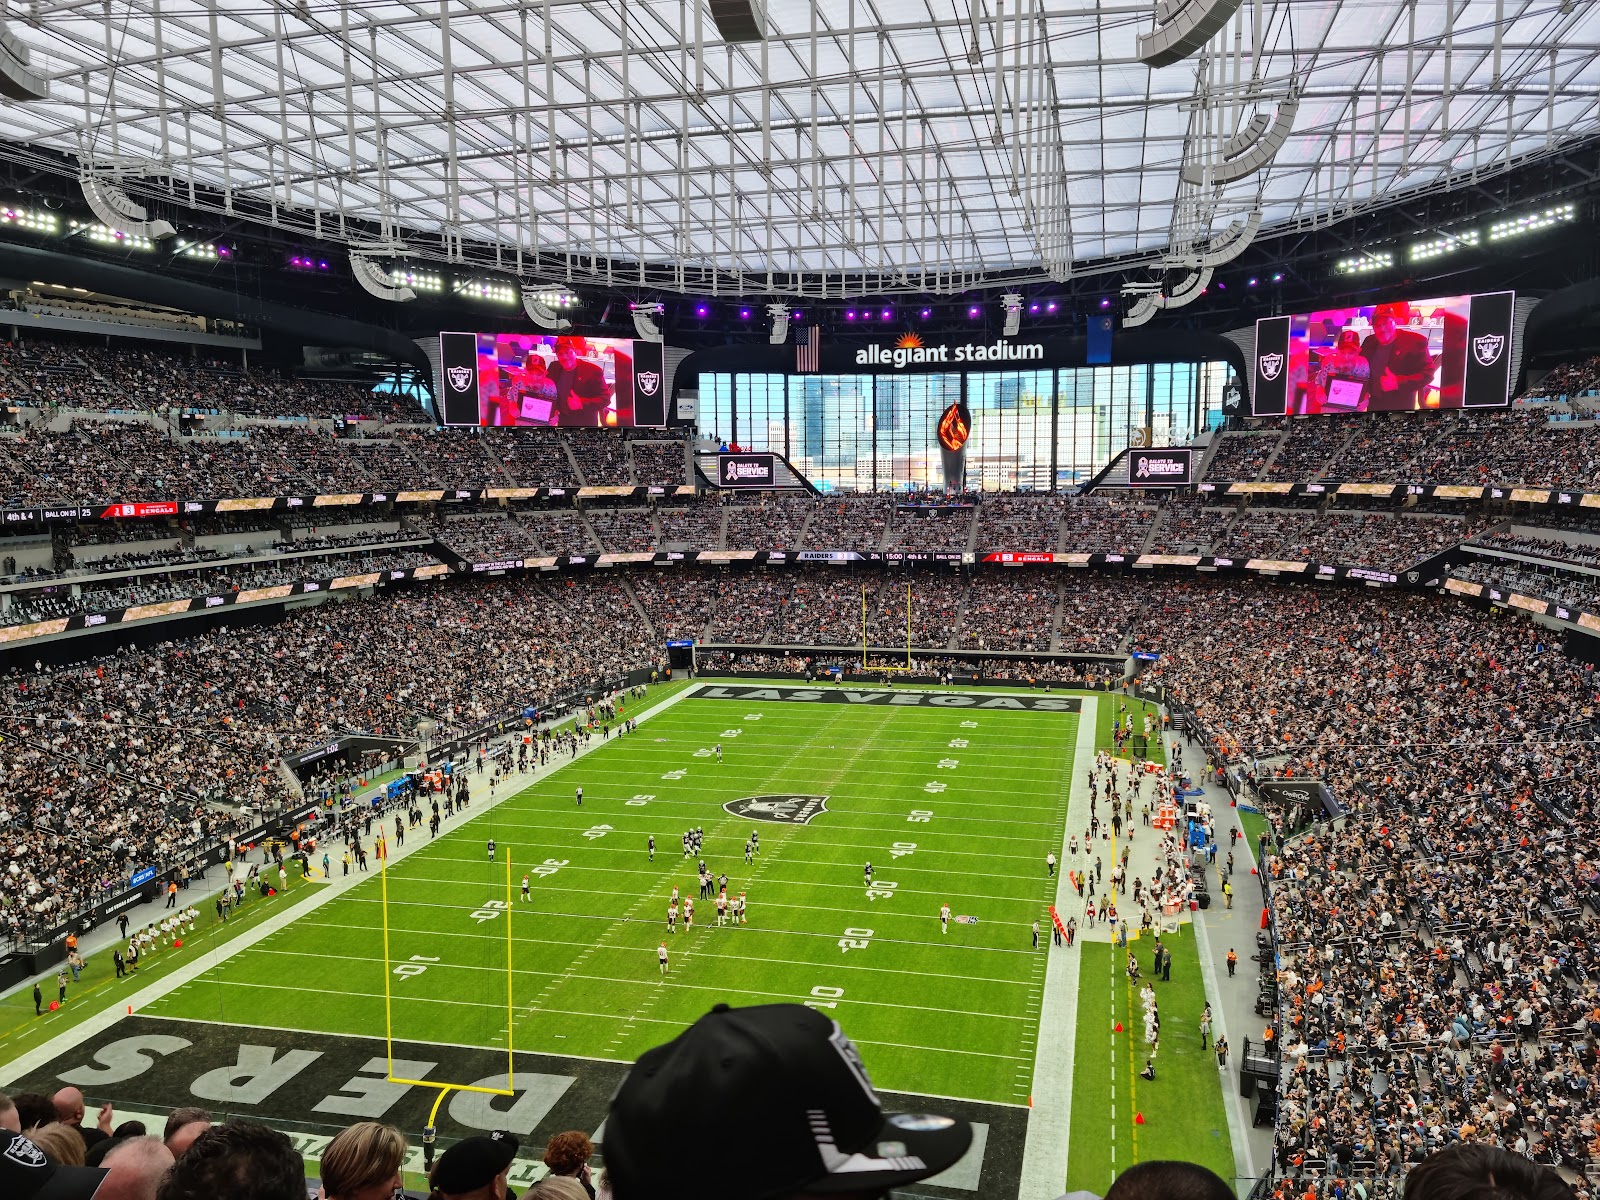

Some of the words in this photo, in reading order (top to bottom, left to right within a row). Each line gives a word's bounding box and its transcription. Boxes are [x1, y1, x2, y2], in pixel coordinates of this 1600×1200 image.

[855, 343, 948, 368] allegiant
[954, 339, 1043, 362] stadium
[737, 467, 768, 475] SERVICE
[1148, 463, 1184, 472] SERVICE
[7, 512, 20, 521] 4th
[20, 512, 27, 521] &
[27, 511, 33, 520] 4
[81, 508, 91, 517] 25
[126, 506, 132, 515] 3
[140, 507, 174, 515] BENGALS
[702, 687, 826, 701] LAS
[843, 692, 1070, 710] VEGAS
[326, 743, 339, 755] 1:02
[625, 794, 657, 806] 50
[906, 809, 934, 823] 50
[531, 858, 570, 874] 30
[865, 880, 898, 899] 30
[469, 900, 514, 920] 20
[837, 927, 875, 949] 20
[392, 954, 441, 976] 10
[803, 985, 845, 1009] 10
